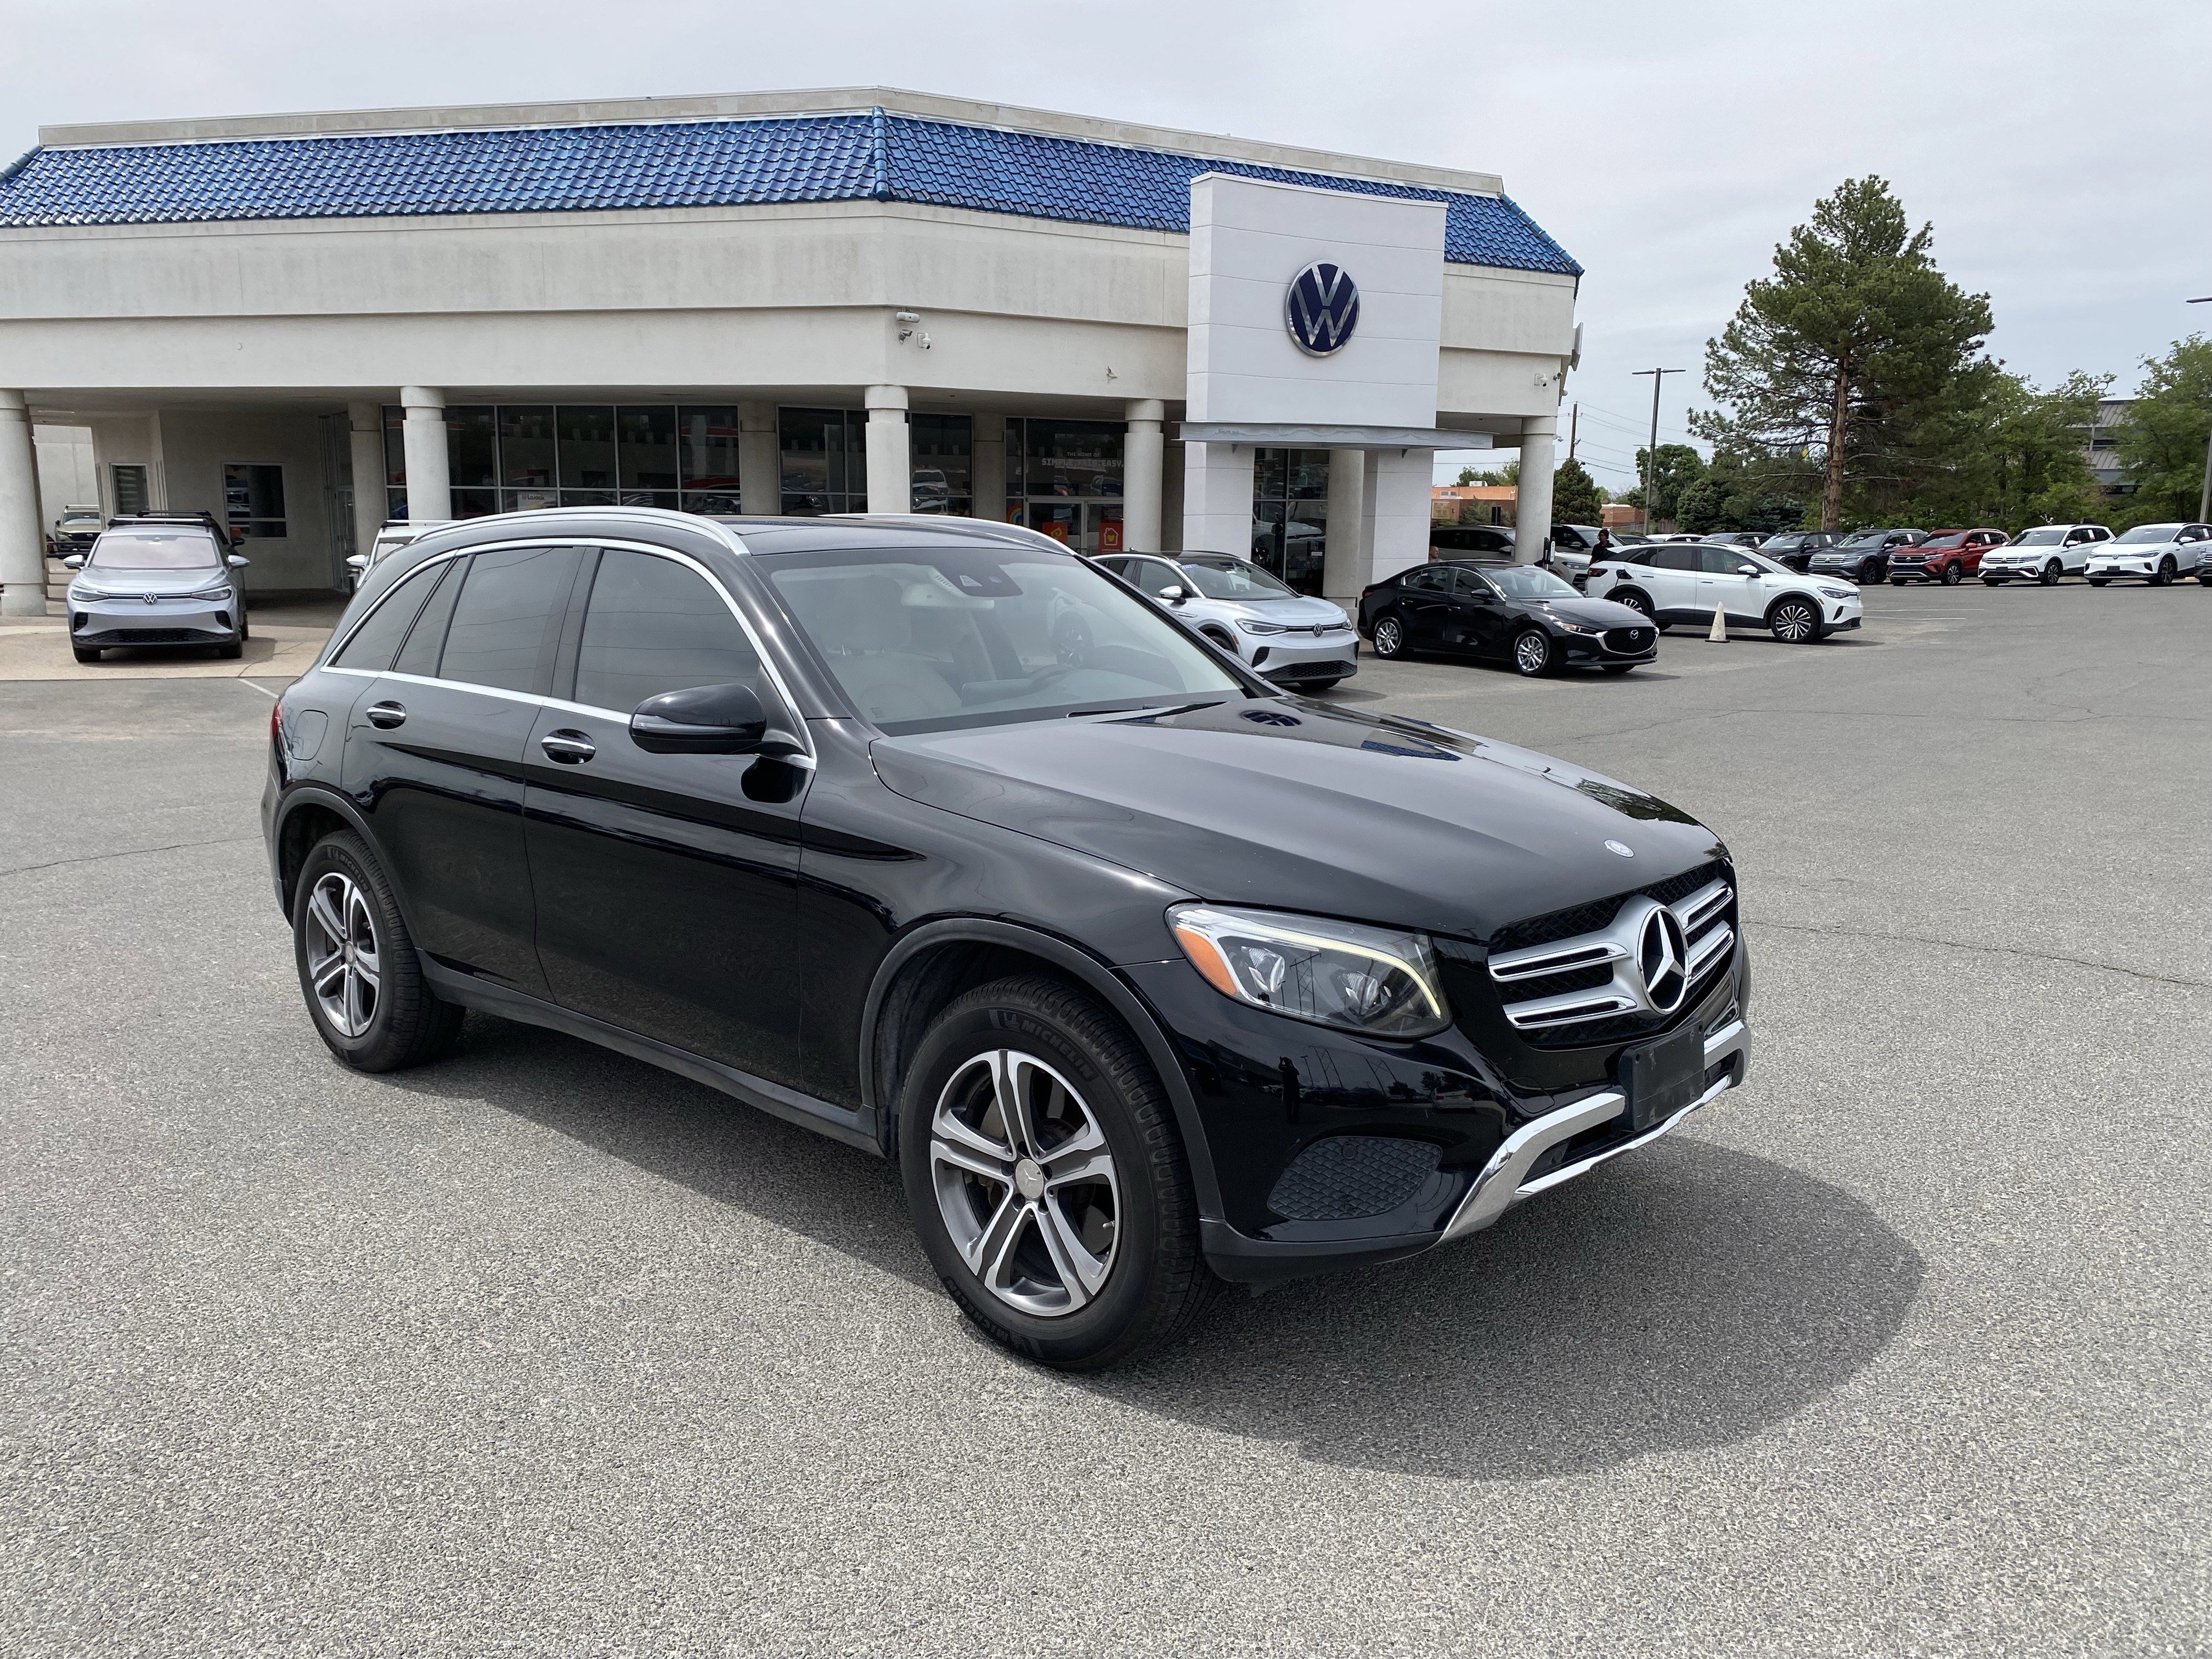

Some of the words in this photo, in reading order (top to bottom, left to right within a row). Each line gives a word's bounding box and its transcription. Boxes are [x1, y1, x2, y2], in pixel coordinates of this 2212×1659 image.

[1288, 262, 1358, 352] VW
[144, 592, 157, 604] VW
[1314, 624, 1322, 636] VW
[340, 853, 368, 891] MICHELIN
[1021, 1019, 1093, 1079] MICHELIN
[945, 1278, 1009, 1342] MICHELIN
